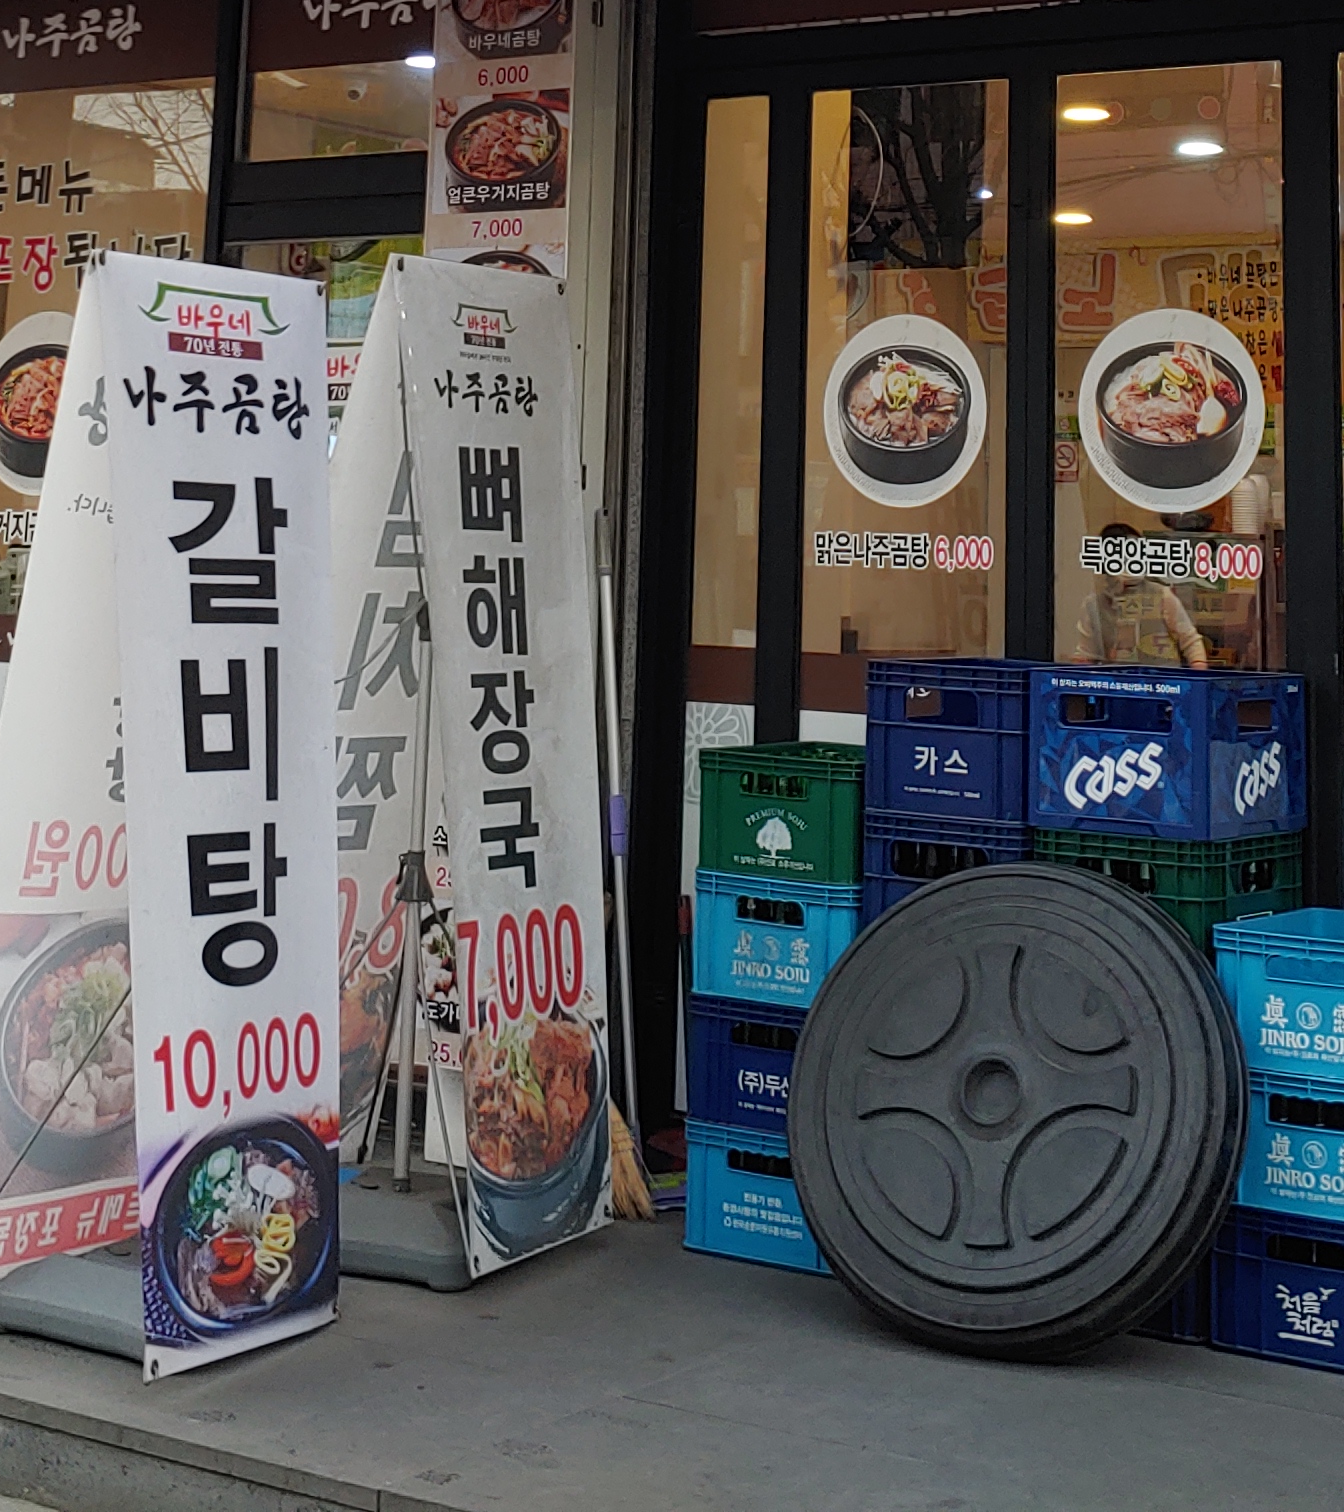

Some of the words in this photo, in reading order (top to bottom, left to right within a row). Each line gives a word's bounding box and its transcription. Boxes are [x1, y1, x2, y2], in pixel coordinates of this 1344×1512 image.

[1, 3, 144, 59] 나주곰탕
[467, 28, 542, 51] 바우네곰탕
[477, 64, 529, 88] 6,000
[446, 181, 552, 206] 얼큰우거지곰탕
[471, 217, 524, 241] 7,000
[176, 302, 253, 339] 바우네
[183, 336, 217, 354] 70년
[218, 339, 245, 357] 전통
[122, 365, 311, 441] 나주곰탕
[433, 368, 539, 418] 나주곰탕
[814, 531, 930, 569] 맑은나주곰탕
[934, 536, 994, 572] 6,000
[1194, 544, 1263, 579] 8,000
[458, 445, 541, 889] 뼈해장국
[167, 475, 290, 988] 갈비탕
[913, 745, 969, 777] 카스
[457, 902, 584, 1042] 7,000
[1259, 1027, 1310, 1050] JINRO
[153, 1011, 323, 1115] 10,000
[1264, 1165, 1316, 1189] JINRO
[1276, 1283, 1322, 1316] 처음
[1288, 1312, 1335, 1339] 처럼
